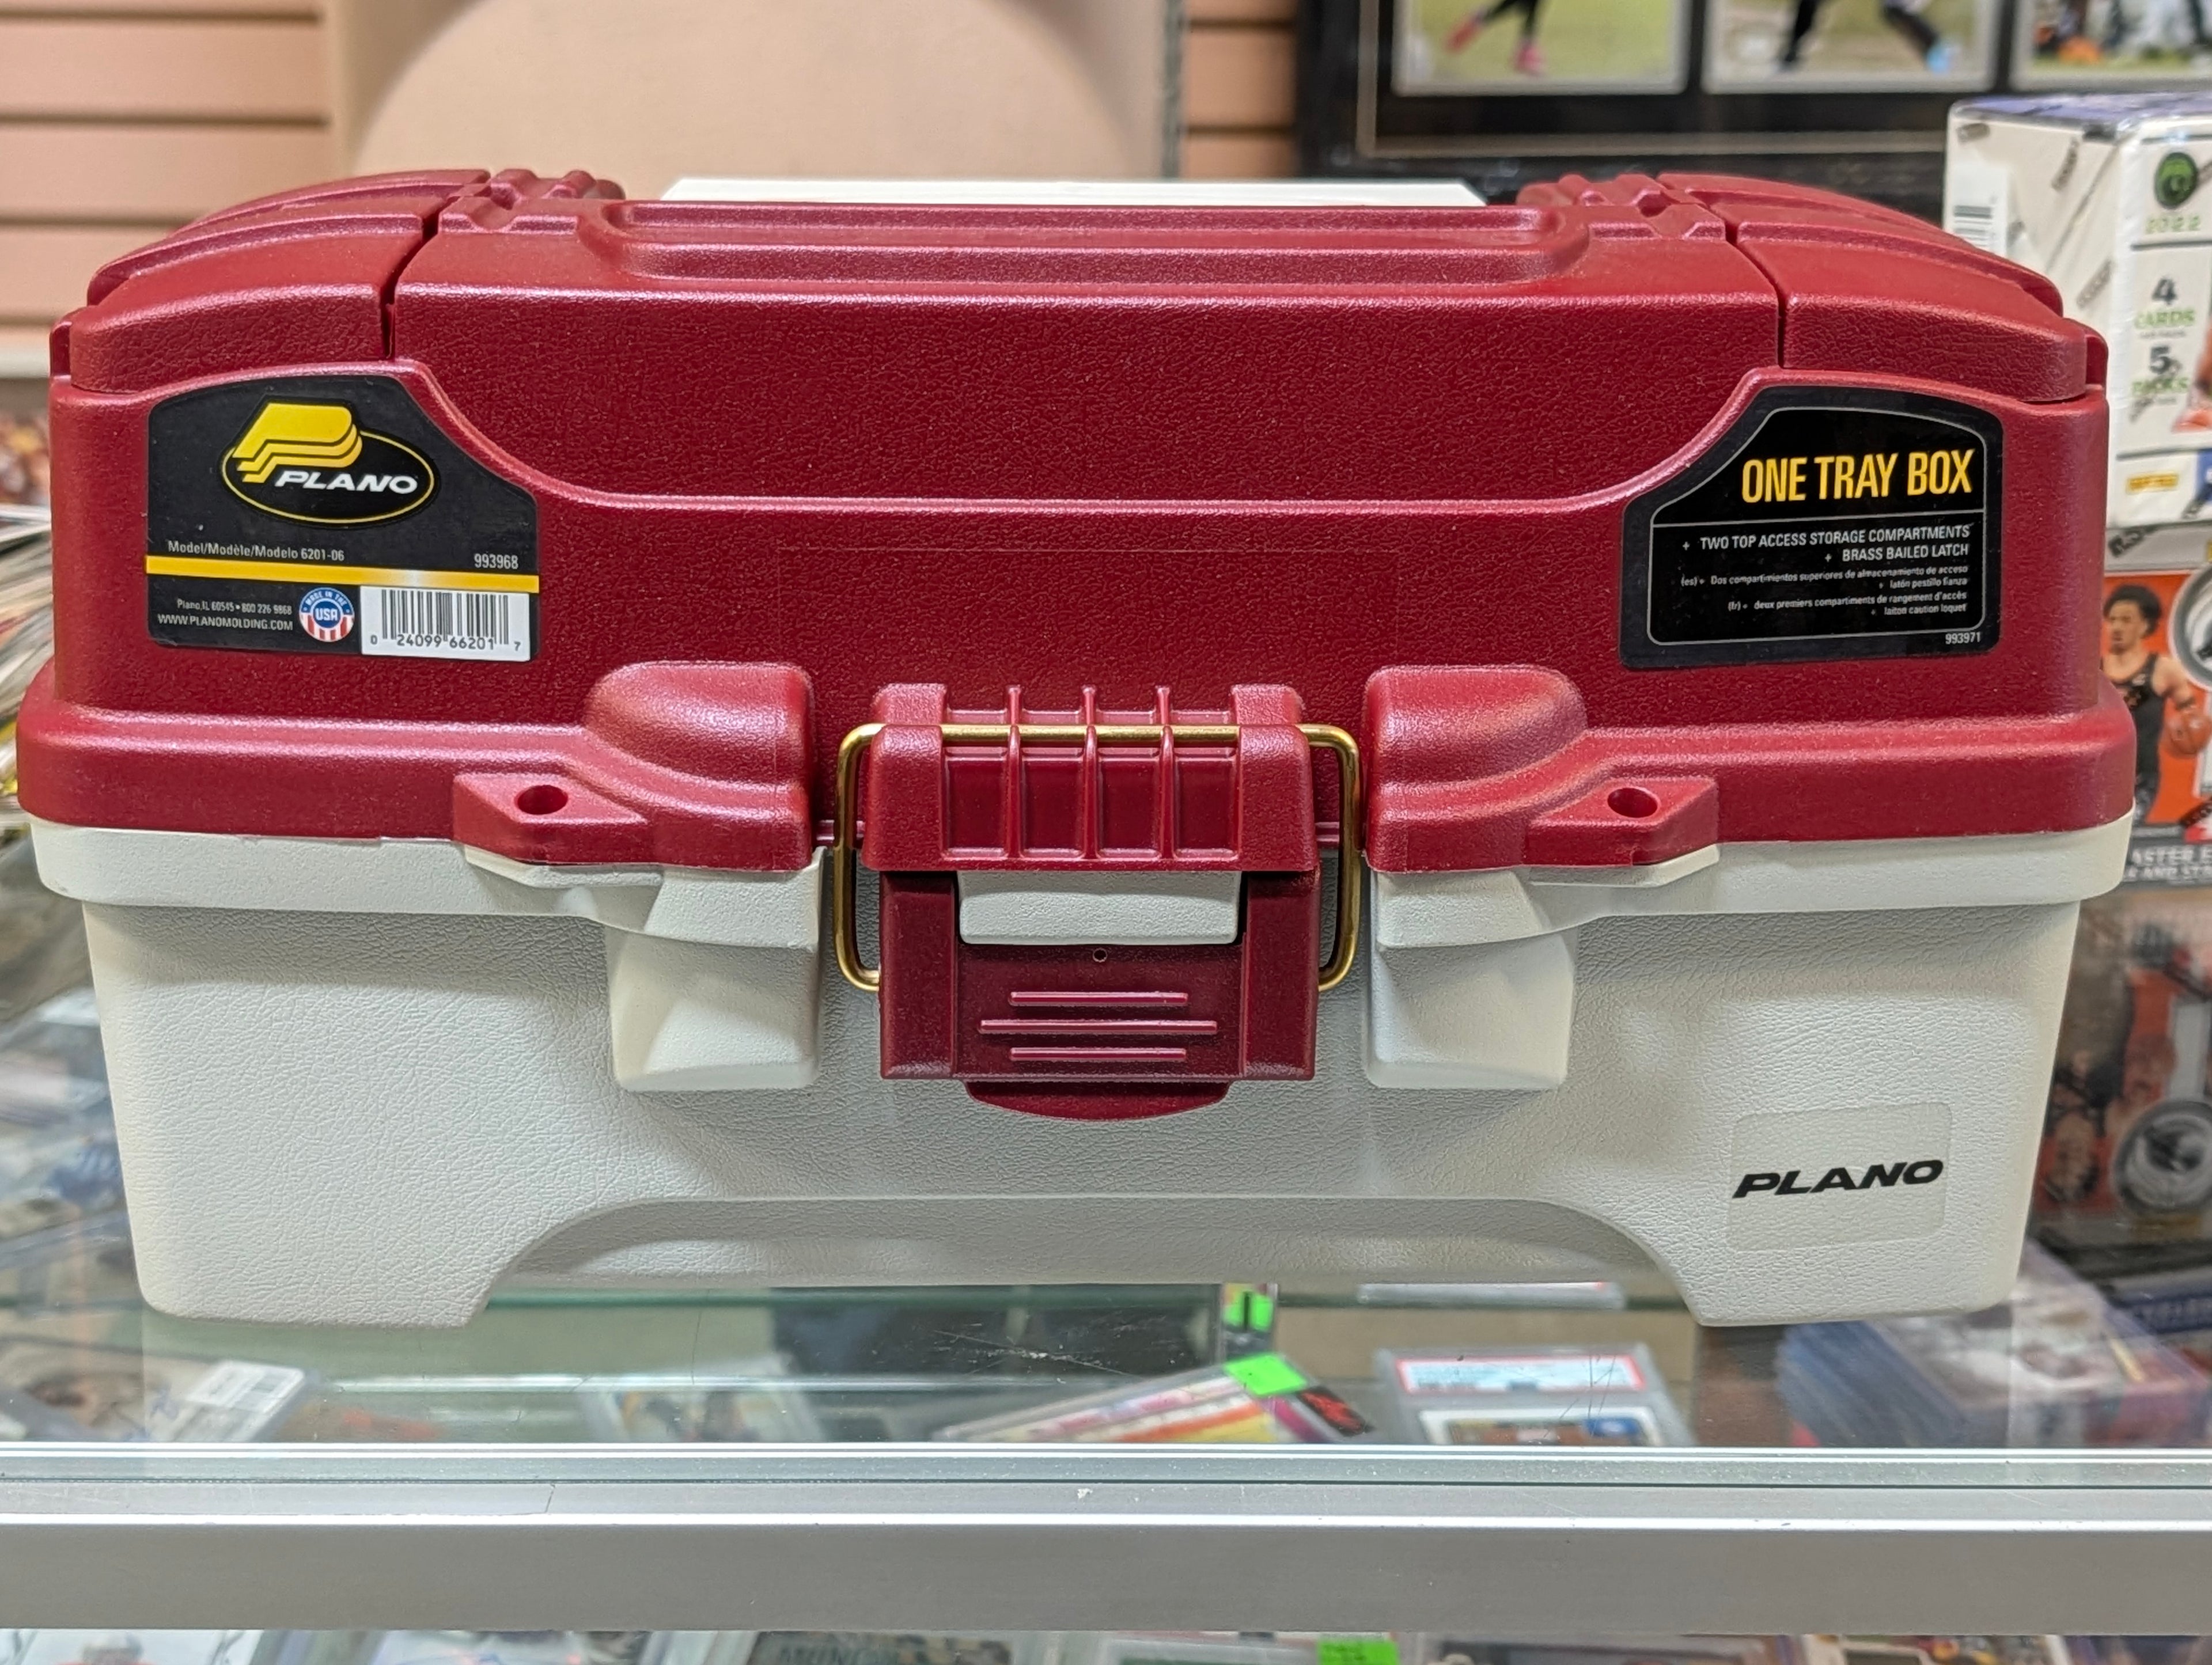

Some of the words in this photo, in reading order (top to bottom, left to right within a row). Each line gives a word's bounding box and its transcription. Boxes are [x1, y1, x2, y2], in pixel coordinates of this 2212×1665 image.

[2152, 278, 2178, 306] 4
[2149, 345, 2172, 374] 5
[275, 471, 418, 494] PLANO
[1742, 457, 1808, 503] ONE
[1814, 452, 1899, 500] TRAY
[1907, 448, 1975, 496] BOX
[1700, 536, 1729, 549] TWO
[1732, 536, 1756, 548] TOP
[1758, 533, 1806, 547] ACCESS
[1809, 529, 1866, 545] STORAGE
[1868, 524, 1970, 543] COMPARTMENTS
[301, 547, 345, 562] 6201-06
[474, 553, 518, 570] 993968
[1842, 547, 1883, 562] BRASS
[1885, 544, 1929, 560] BAILED
[1931, 543, 1968, 557] LATCH
[1710, 575, 1727, 585] Dos
[1799, 571, 1843, 582] superiores
[1844, 568, 1856, 578] de
[1926, 566, 1936, 575] de
[1938, 566, 1968, 574] acceso
[1753, 600, 1774, 609] deux
[1776, 599, 1813, 609] premiers
[1877, 595, 1887, 604] de
[1889, 593, 1933, 604] rangement
[158, 613, 293, 631] WWW.PLANOMOLDING.COM
[315, 608, 338, 621] USA
[370, 635, 377, 645] 0
[397, 634, 441, 647] 24099
[449, 636, 494, 650] 66201
[514, 641, 521, 651] 7
[1945, 632, 1981, 644] 993971
[1732, 1159, 1944, 1199] PLANO
